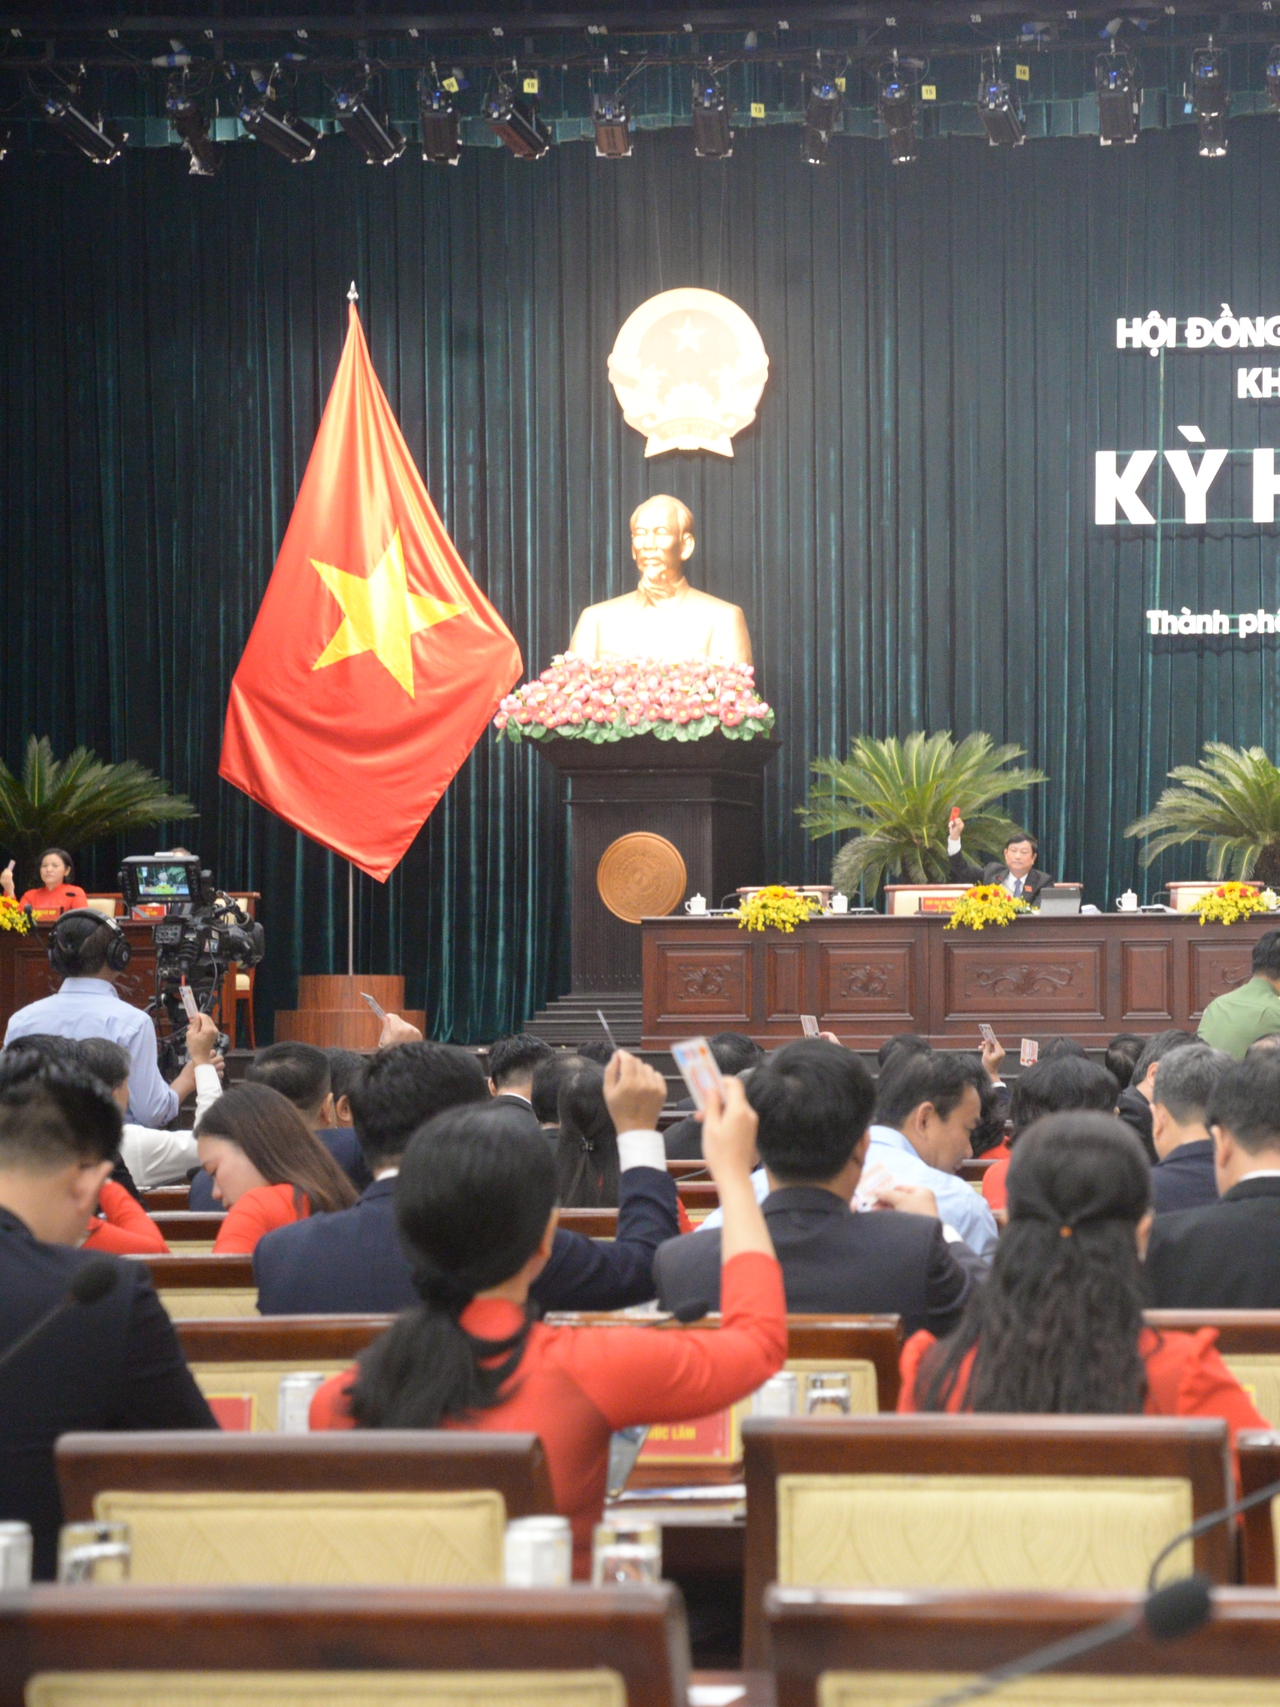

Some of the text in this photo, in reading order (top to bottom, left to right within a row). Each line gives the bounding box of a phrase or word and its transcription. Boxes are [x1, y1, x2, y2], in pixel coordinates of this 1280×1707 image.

[1066, 10, 1077, 19] 37
[1262, 2, 1272, 10] 21
[885, 17, 897, 26] 02
[1116, 310, 1177, 357] HỘI
[1094, 424, 1230, 526] KỲ
[1146, 606, 1231, 635] Thành
